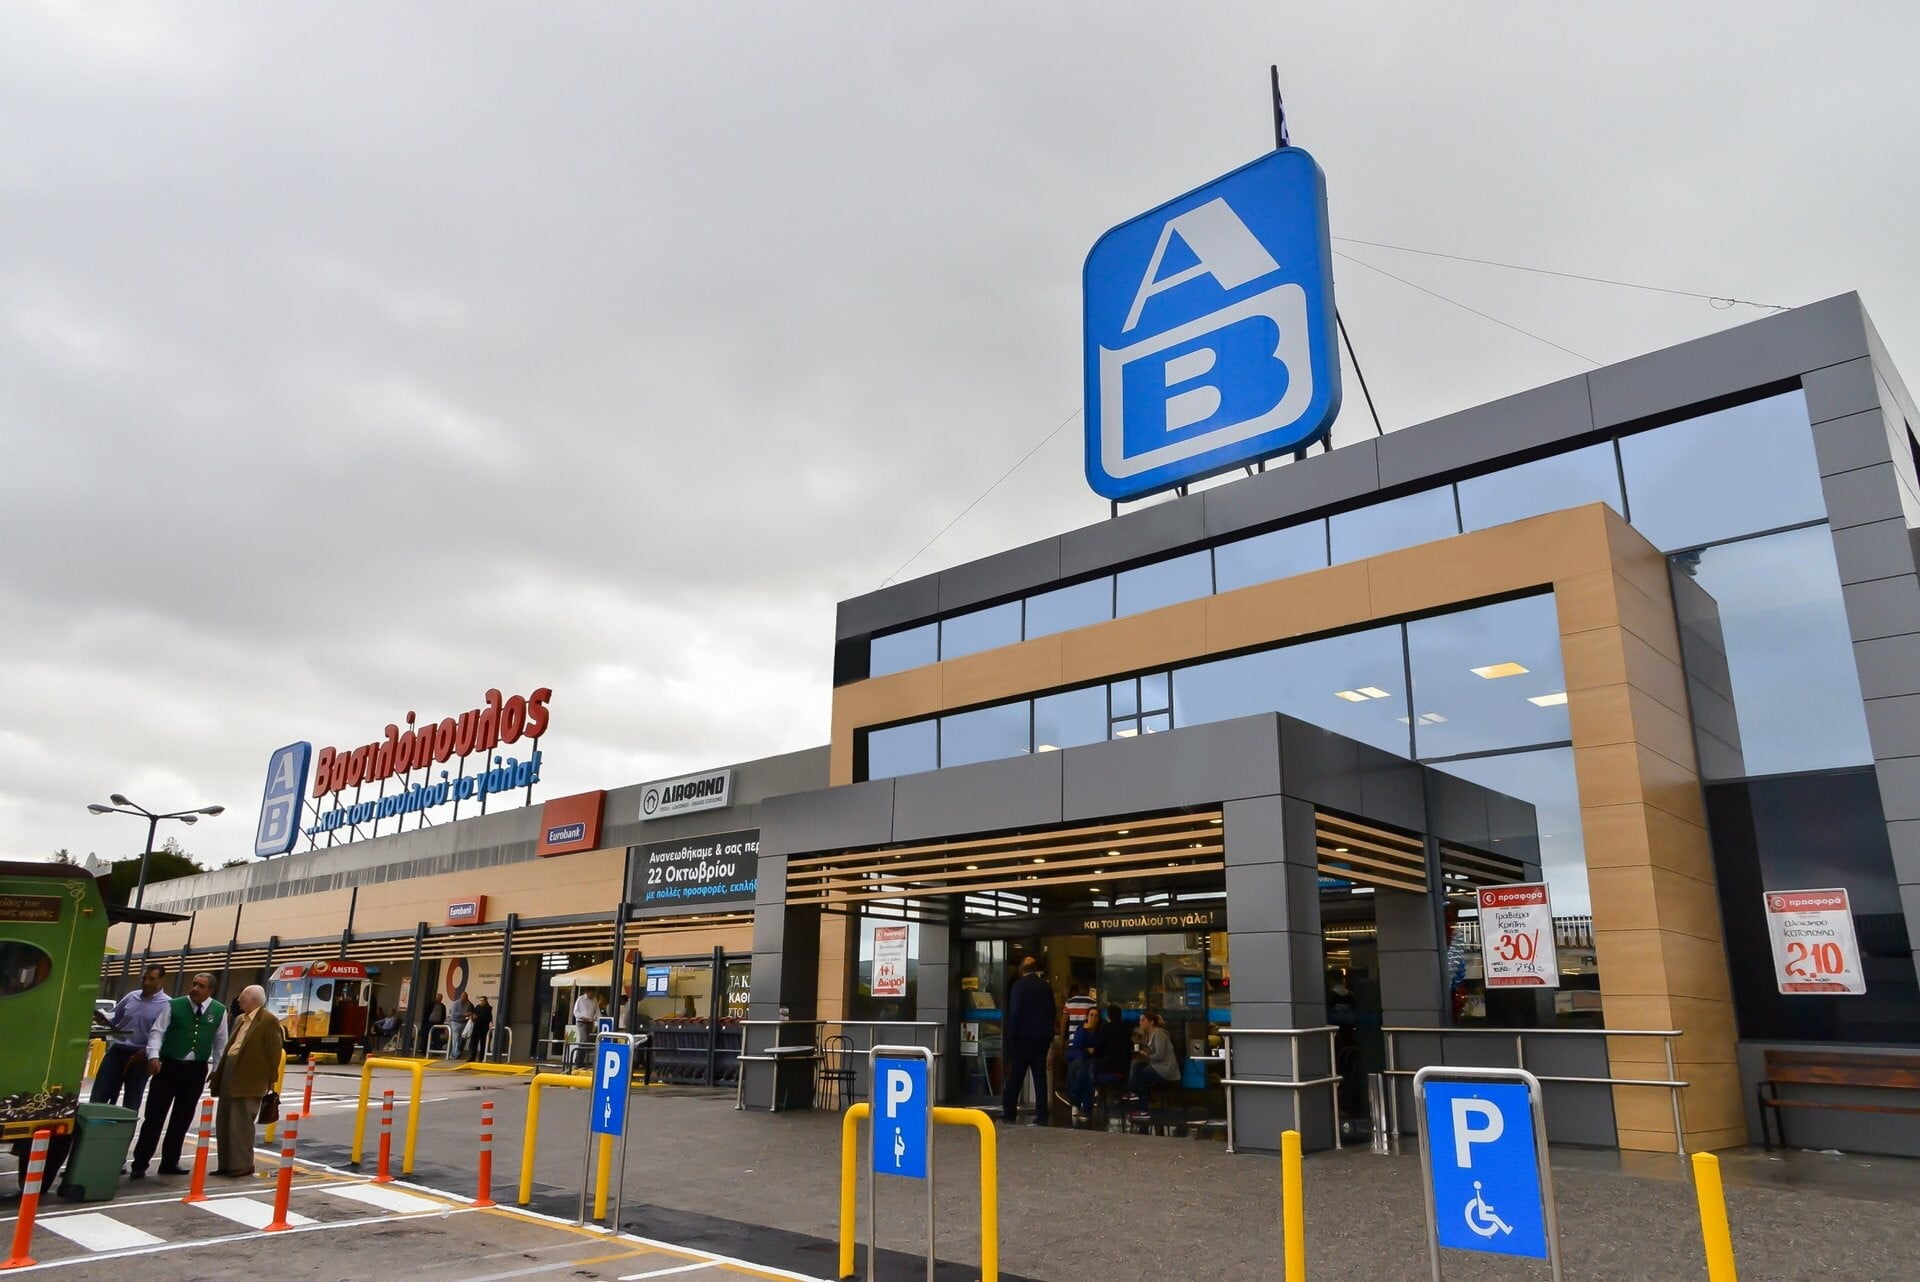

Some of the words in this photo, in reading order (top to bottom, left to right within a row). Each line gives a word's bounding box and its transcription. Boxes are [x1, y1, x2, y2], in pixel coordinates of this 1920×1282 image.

[312, 687, 552, 799] Βασιλόπουλος
[347, 801, 374, 825] του
[375, 770, 448, 819] πουλιού
[452, 776, 477, 801] το
[477, 750, 543, 802] γάλα!
[661, 776, 725, 804] ΔΙΑΦΑΝΟ
[549, 826, 581, 842] Eurobank
[649, 846, 713, 864] Ανανεωθήκαμε
[715, 843, 722, 856] &
[724, 843, 742, 855] σας
[647, 867, 662, 885] 22
[665, 860, 736, 883] Οκτωβρίου
[646, 890, 655, 901] με
[656, 886, 681, 899] πολλές
[450, 905, 473, 916] Eurobank
[1084, 919, 1100, 929] και
[1101, 919, 1119, 928] του
[1121, 914, 1163, 928] πουλιού
[1165, 916, 1178, 925] το
[331, 966, 359, 974] AMSTEL
[729, 975, 740, 988] ΤΑ
[602, 1050, 621, 1089] P
[887, 1069, 913, 1118] P
[1451, 1098, 1505, 1168] P
